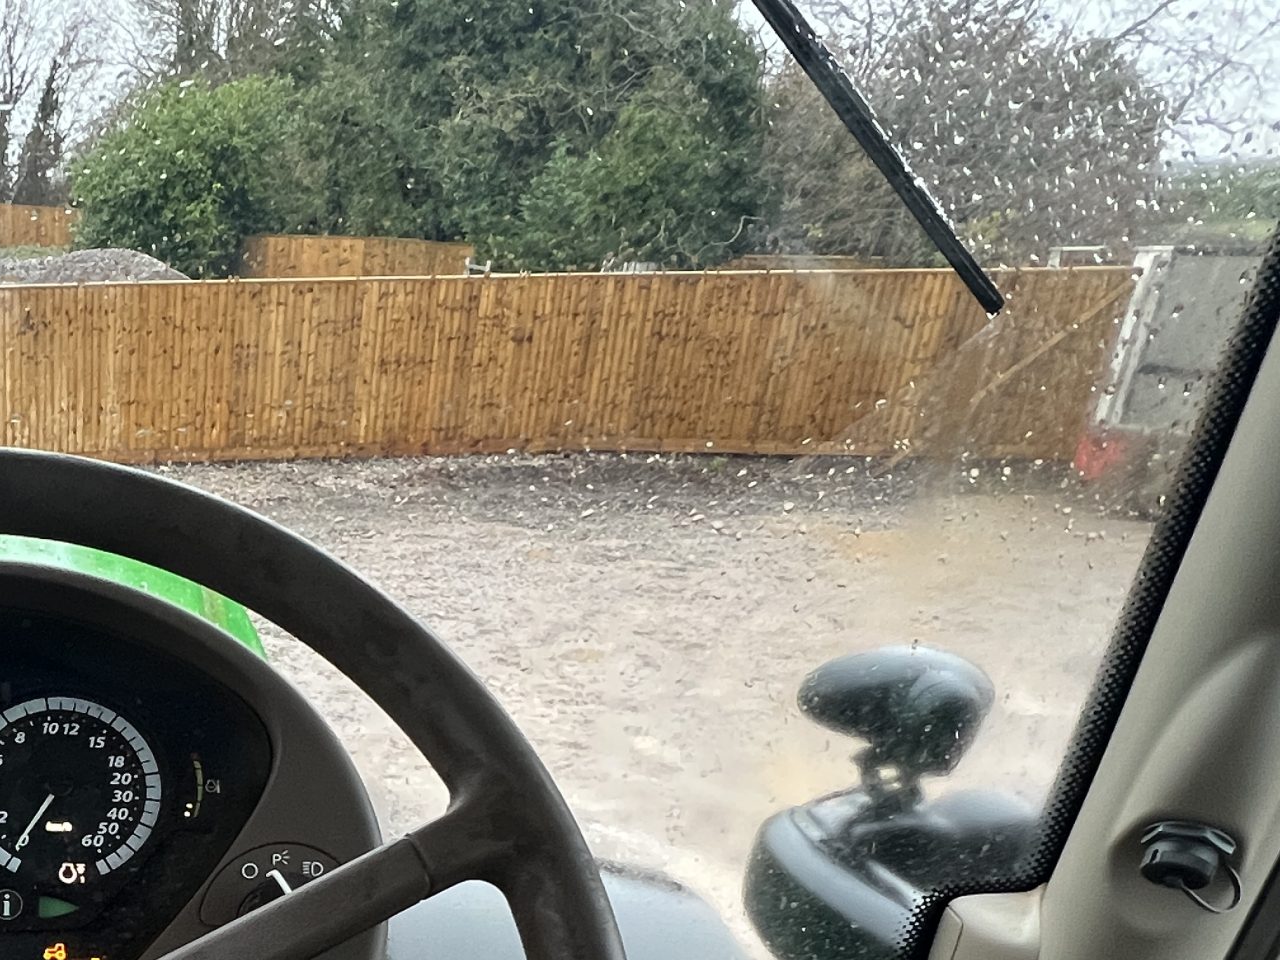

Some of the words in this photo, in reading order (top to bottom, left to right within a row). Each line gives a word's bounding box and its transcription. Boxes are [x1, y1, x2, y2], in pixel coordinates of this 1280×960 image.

[42, 722, 60, 735] 10
[62, 723, 80, 735] 12
[14, 731, 26, 743] 8
[88, 736, 106, 748] 15
[108, 755, 125, 768] 18
[110, 773, 132, 785] 20
[112, 790, 134, 803] 30
[107, 807, 129, 820] 40
[97, 822, 120, 835] 50
[81, 834, 104, 847] 60
